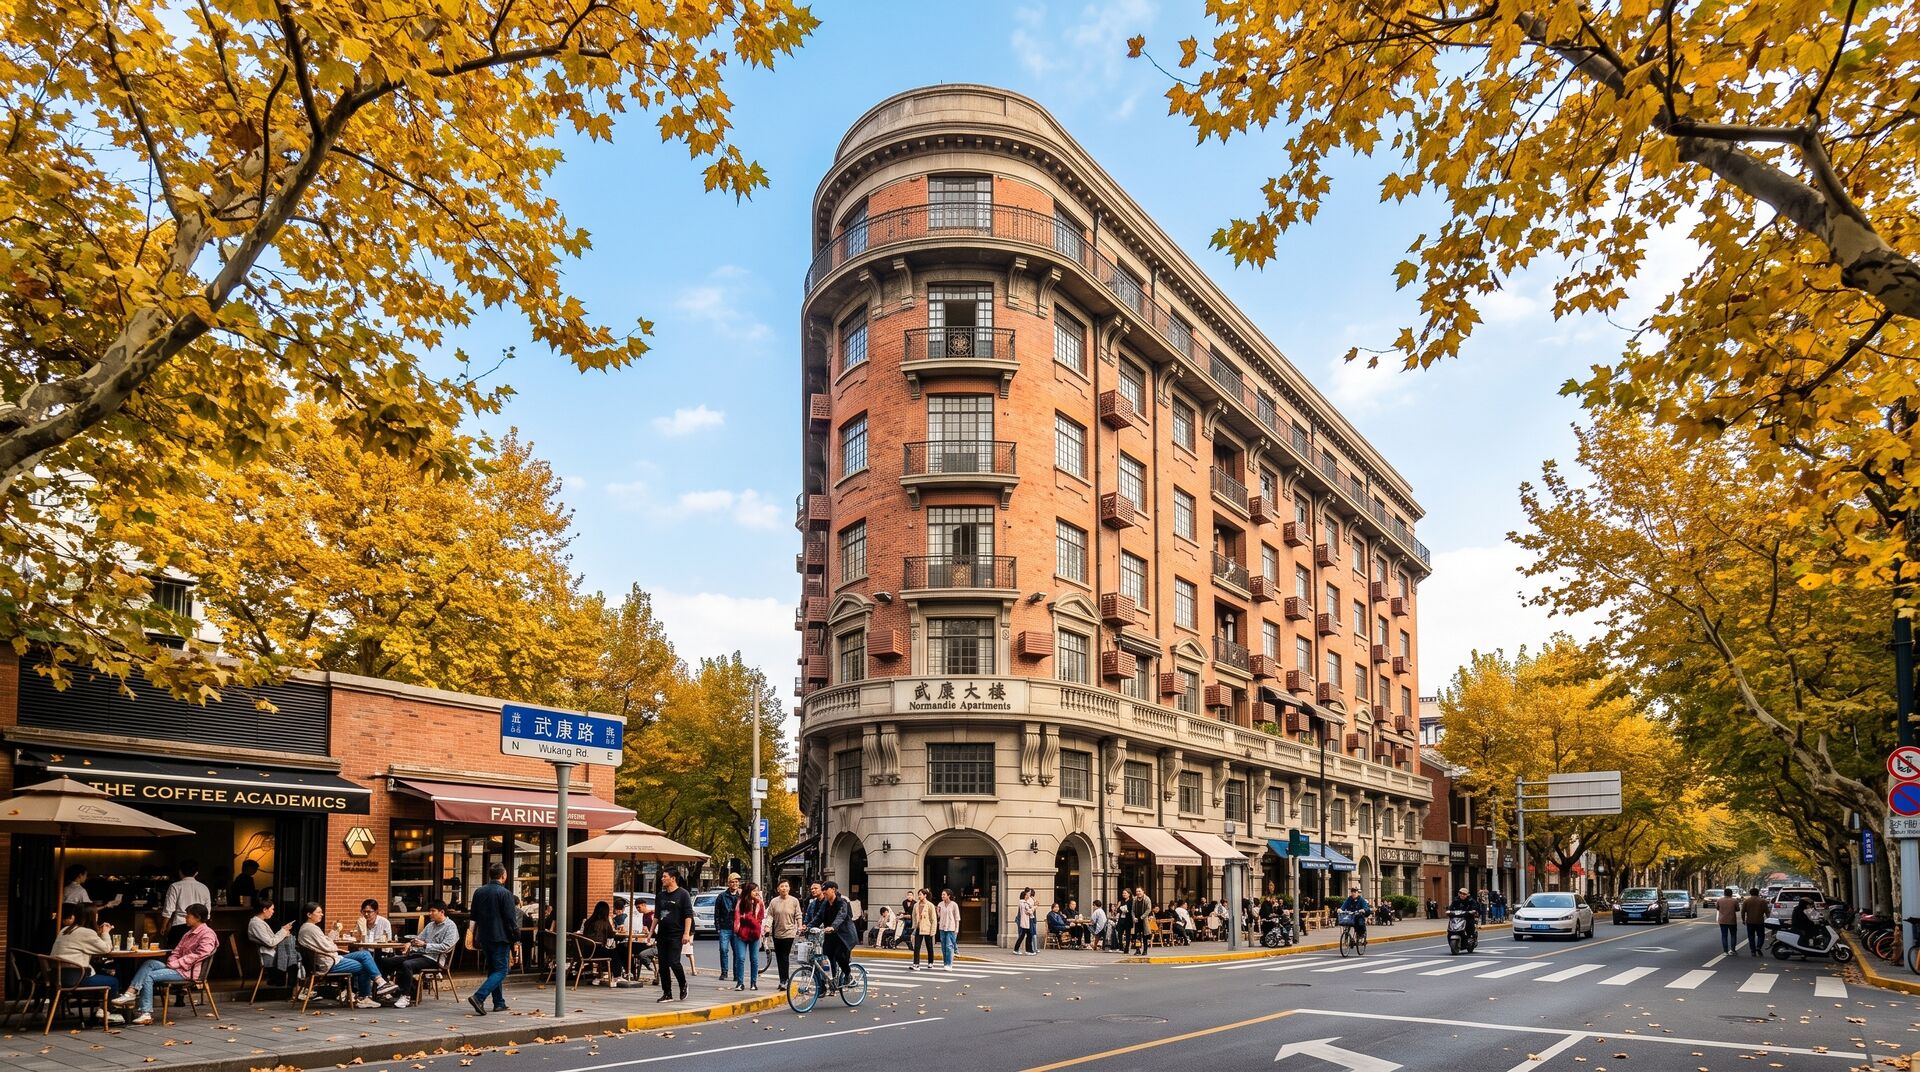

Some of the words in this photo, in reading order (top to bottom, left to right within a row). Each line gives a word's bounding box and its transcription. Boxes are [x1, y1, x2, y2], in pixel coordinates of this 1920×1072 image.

[914, 681, 1006, 700] 武康大楼
[909, 701, 956, 710] Normandie
[960, 701, 1011, 711] Apartments
[534, 716, 594, 743] 武康路
[512, 741, 520, 750] N
[539, 743, 572, 757] Wukang
[575, 747, 589, 758] Rd.
[607, 751, 613, 761] E
[142, 785, 228, 803] COFFEE
[233, 791, 347, 810] ACADEMICS
[491, 807, 556, 824] FARINE
